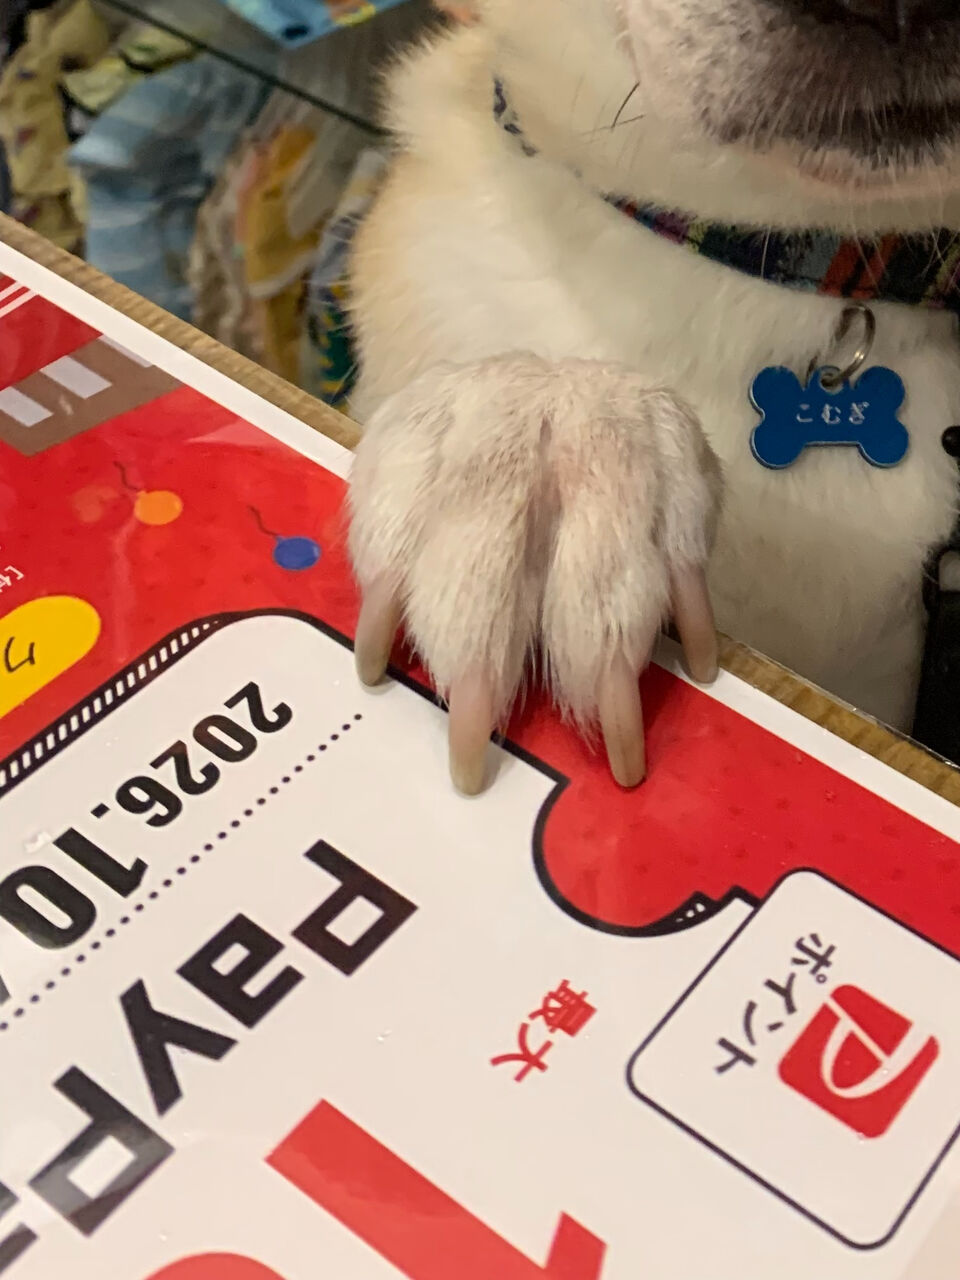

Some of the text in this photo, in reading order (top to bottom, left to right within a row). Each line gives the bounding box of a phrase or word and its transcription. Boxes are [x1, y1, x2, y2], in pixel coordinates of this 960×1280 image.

[796, 400, 870, 425] こむぎ
[0, 682, 293, 1004] 2026.10
[489, 979, 597, 1082] 最大
[713, 932, 837, 1075] ポイント
